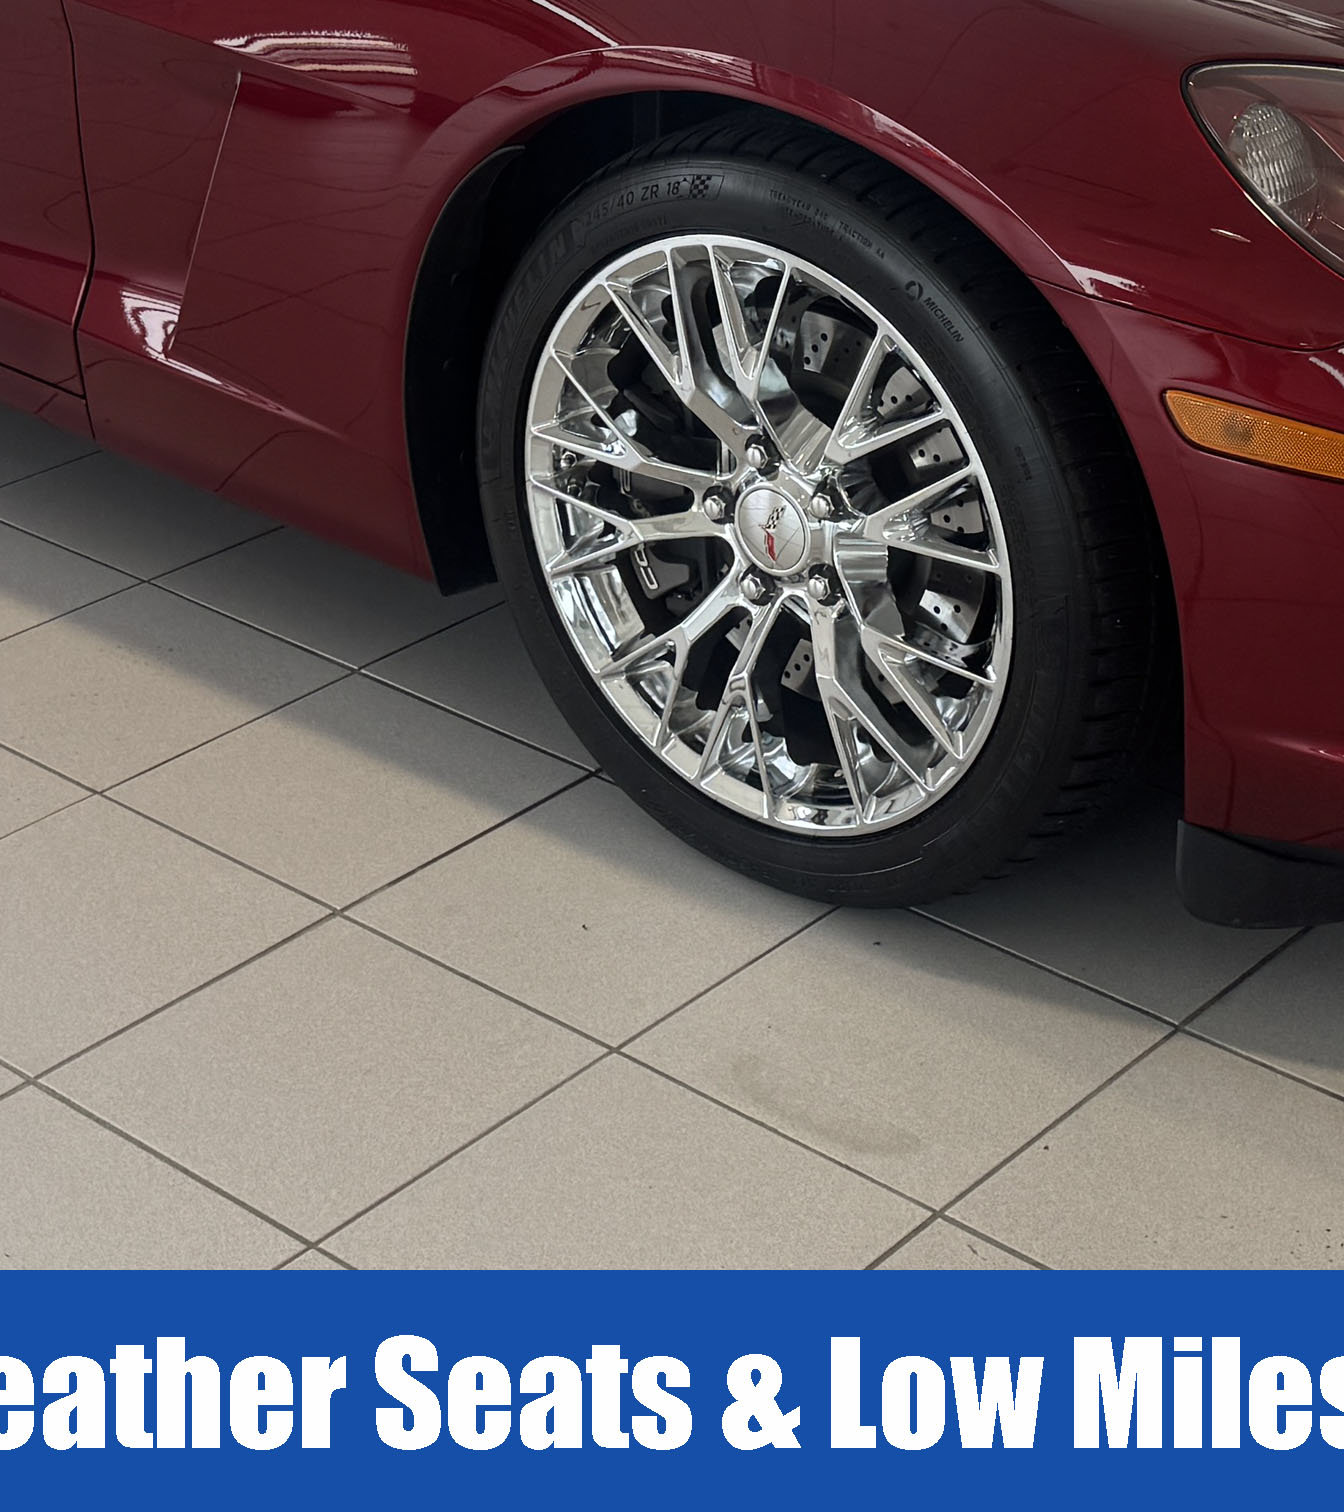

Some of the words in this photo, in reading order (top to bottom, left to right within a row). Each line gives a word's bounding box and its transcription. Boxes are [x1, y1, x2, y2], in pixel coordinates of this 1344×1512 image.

[640, 184, 660, 202] ZR
[666, 180, 681, 196] 18
[923, 297, 965, 343] MICHELIN
